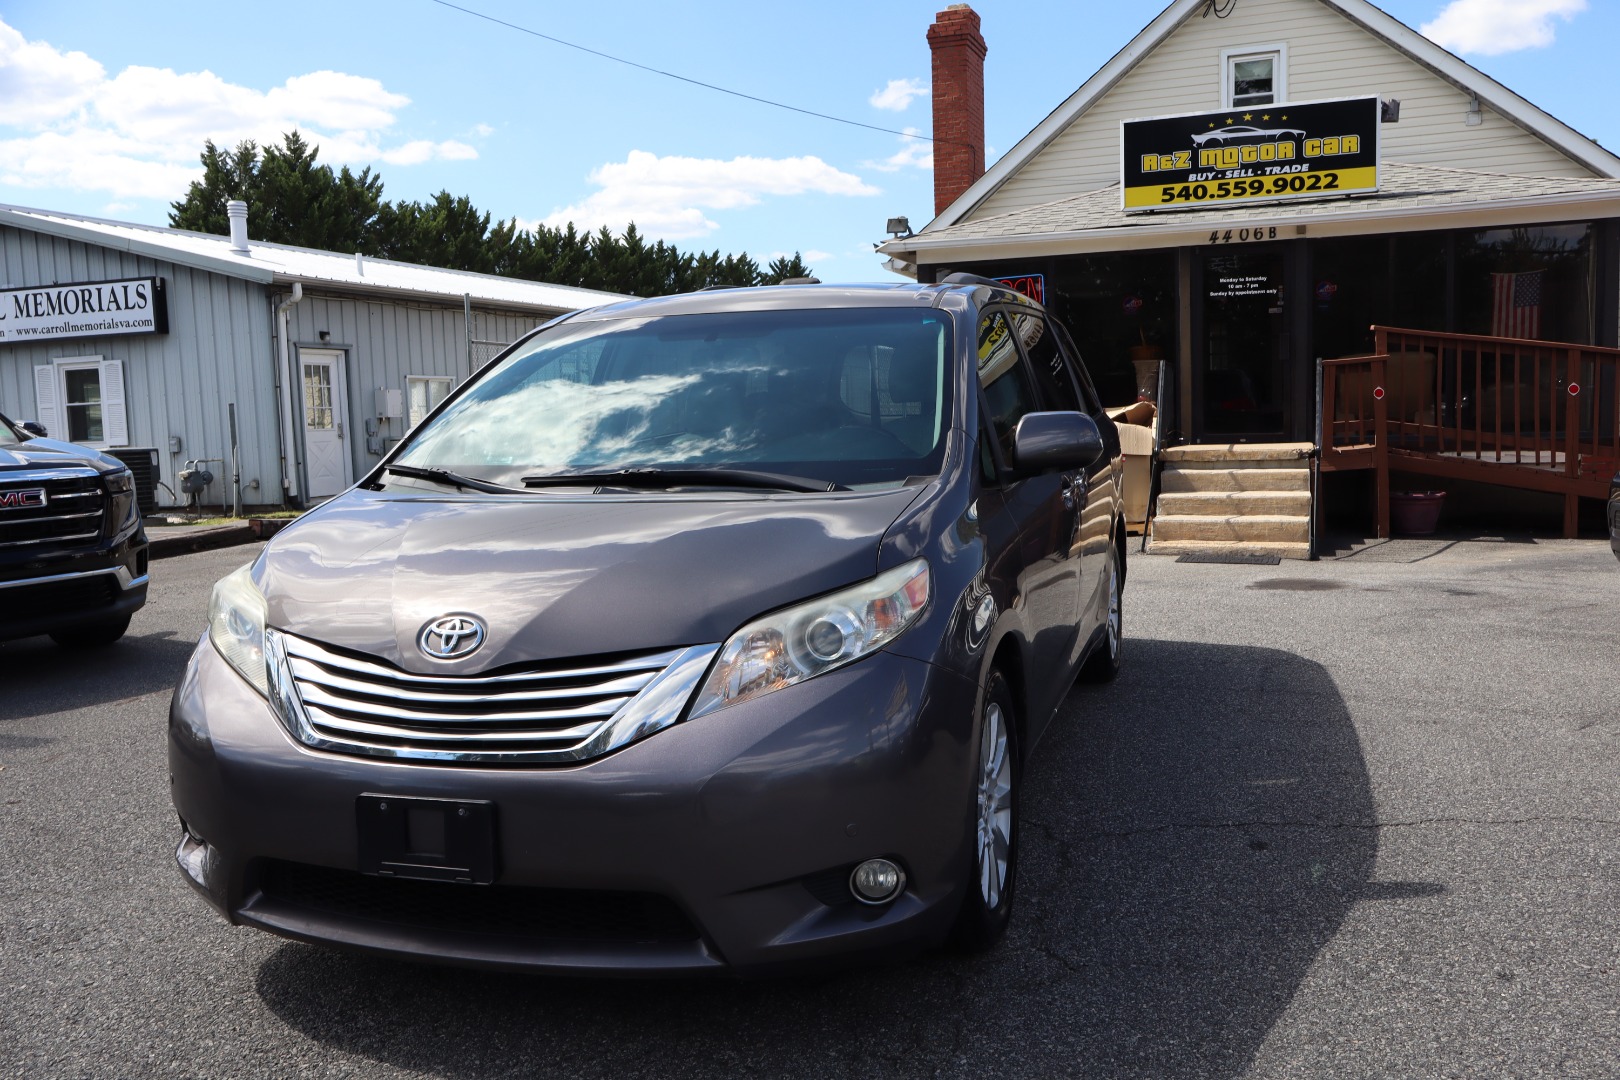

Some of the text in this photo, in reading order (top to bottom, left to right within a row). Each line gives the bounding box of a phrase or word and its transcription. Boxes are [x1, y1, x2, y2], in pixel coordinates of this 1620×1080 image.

[1188, 163, 1310, 182] BUY SELL TRADE
[1161, 172, 1339, 203] 540.559.9022
[1208, 226, 1277, 244] 4406B
[13, 283, 148, 319] MEMORIALS
[16, 318, 153, 336] www.carrollmemorialsva.com
